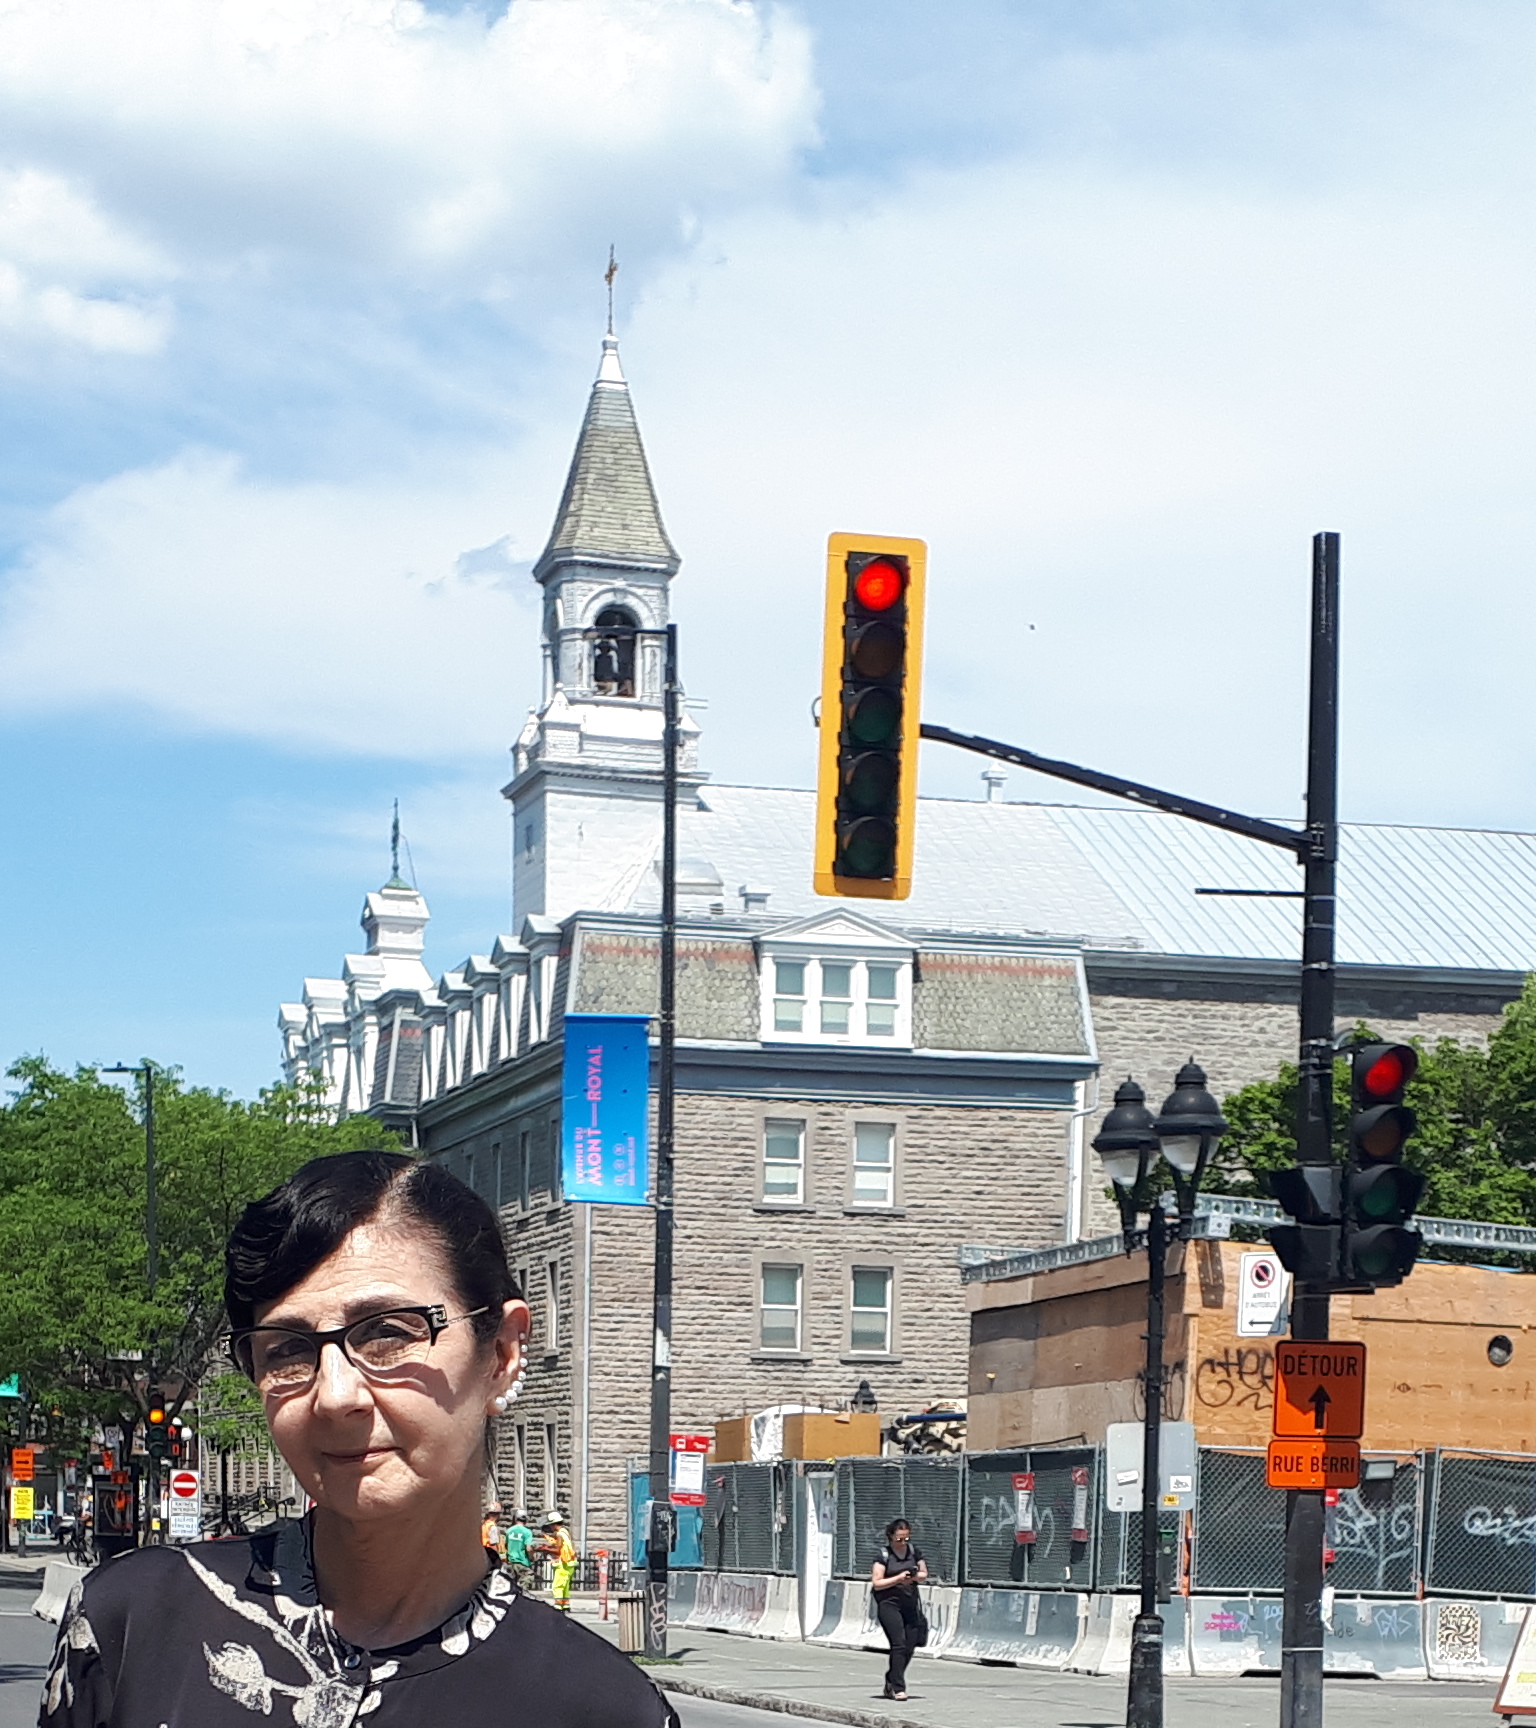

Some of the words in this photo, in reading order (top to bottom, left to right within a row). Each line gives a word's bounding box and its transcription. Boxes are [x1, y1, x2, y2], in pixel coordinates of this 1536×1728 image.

[1283, 1350, 1358, 1377] DÉTOUR
[1272, 1455, 1304, 1473] RUE
[1310, 1456, 1355, 1473] BERRI
